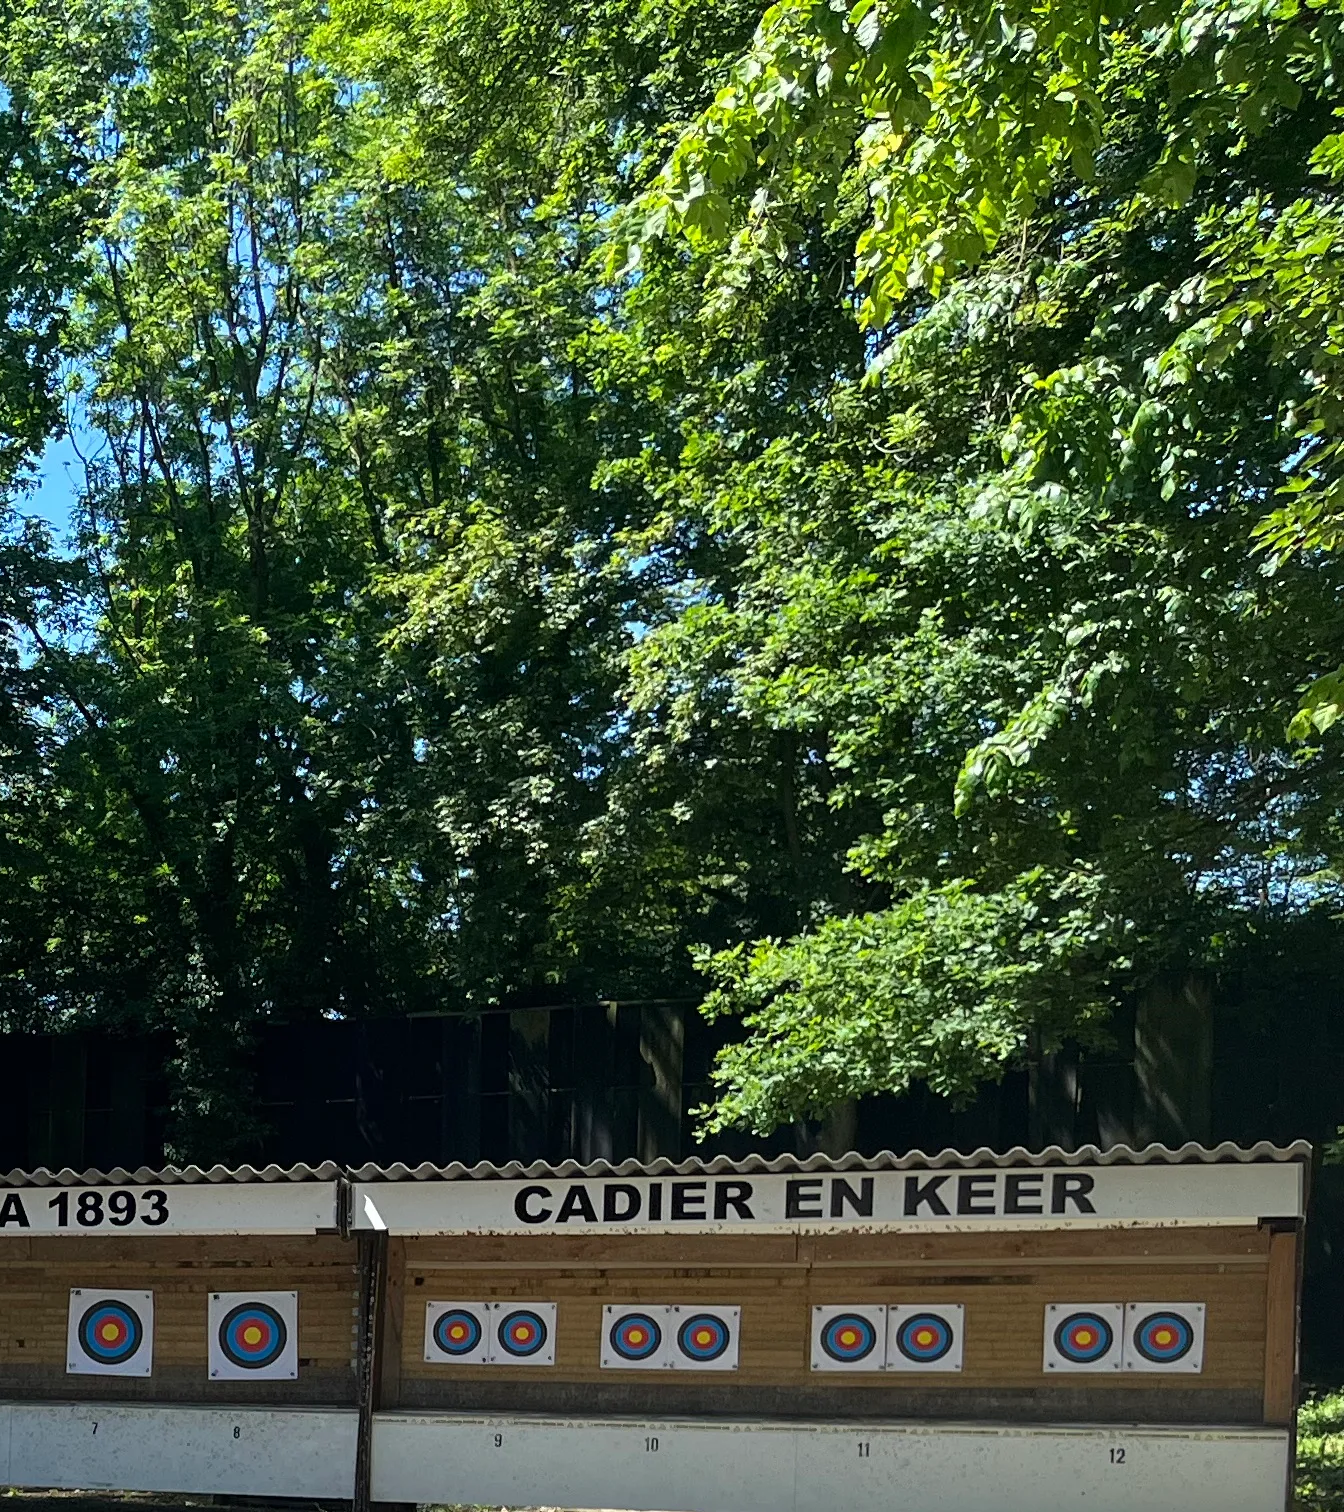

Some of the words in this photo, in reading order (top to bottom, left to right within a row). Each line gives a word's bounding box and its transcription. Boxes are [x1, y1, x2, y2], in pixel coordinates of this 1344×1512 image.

[514, 1180, 756, 1224] CADIER
[784, 1176, 875, 1220] EN
[903, 1172, 1097, 1217] KEER
[48, 1189, 170, 1227] 1893
[91, 1421, 99, 1435] 7
[233, 1425, 241, 1440] 8
[494, 1433, 503, 1448] 9
[644, 1437, 659, 1452] 10
[857, 1442, 870, 1458] 11
[1109, 1448, 1126, 1464] 12
